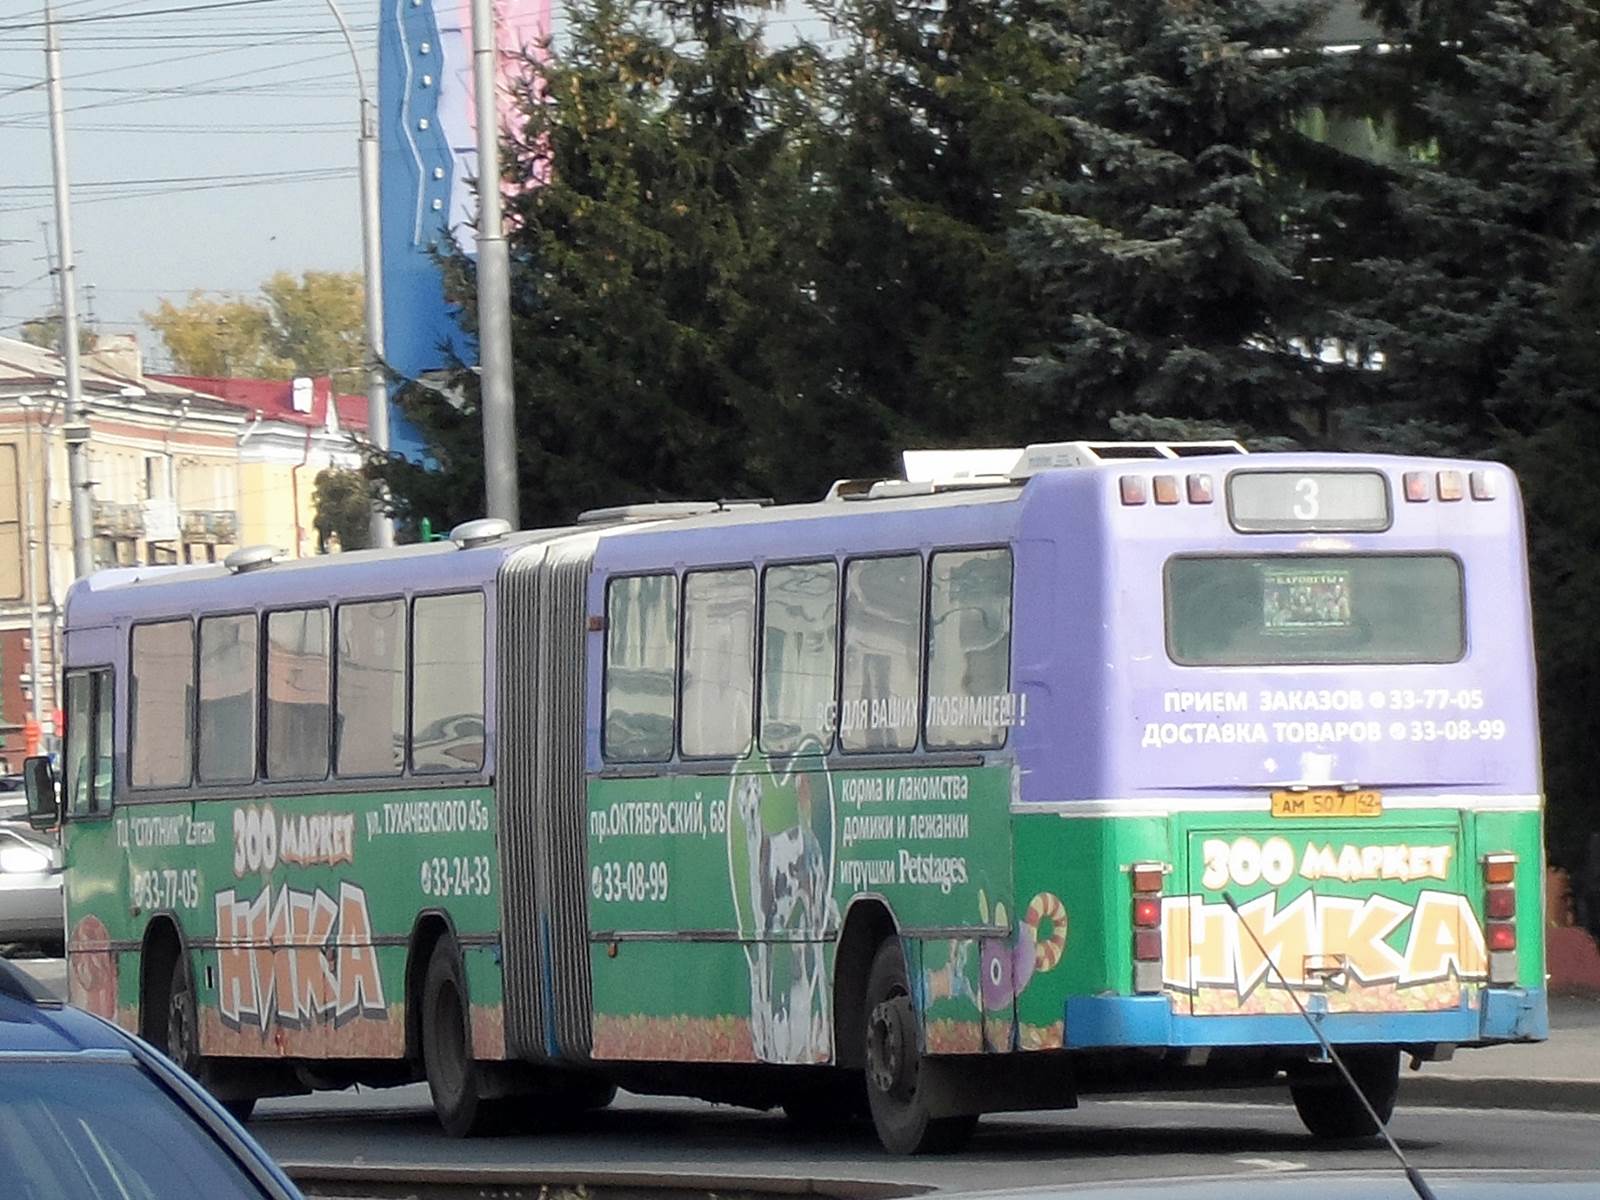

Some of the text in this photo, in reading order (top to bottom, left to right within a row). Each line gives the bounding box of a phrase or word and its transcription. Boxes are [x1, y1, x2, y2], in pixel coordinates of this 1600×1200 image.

[1293, 478, 1319, 519] 3
[840, 698, 869, 738] ДЛЯ
[871, 695, 919, 729] ВАШИХ
[1164, 689, 1484, 712] ПРИЕМ ЗАКАЗОВ 33-77-05
[1141, 720, 1506, 748] ДОСТАВКА ТОВАРОВ 33-08-99
[841, 774, 968, 810] корма и лакомства
[1313, 795, 1346, 811] 507
[384, 800, 466, 834] ТУХАЧЕВСКОГО
[710, 799, 725, 833] 68
[843, 813, 969, 847] домики и лежанки
[234, 804, 355, 878] ЗОО МАРКЕТ
[432, 856, 490, 896] 33-24-33
[604, 861, 668, 902] 33-08-99
[841, 849, 968, 894] игрушки Petstages
[1202, 836, 1451, 889] ЗОО МАРКЕТ
[144, 869, 199, 909] 33-77-05
[215, 881, 386, 1030] НИКА
[1162, 889, 1488, 1003] НИКА
